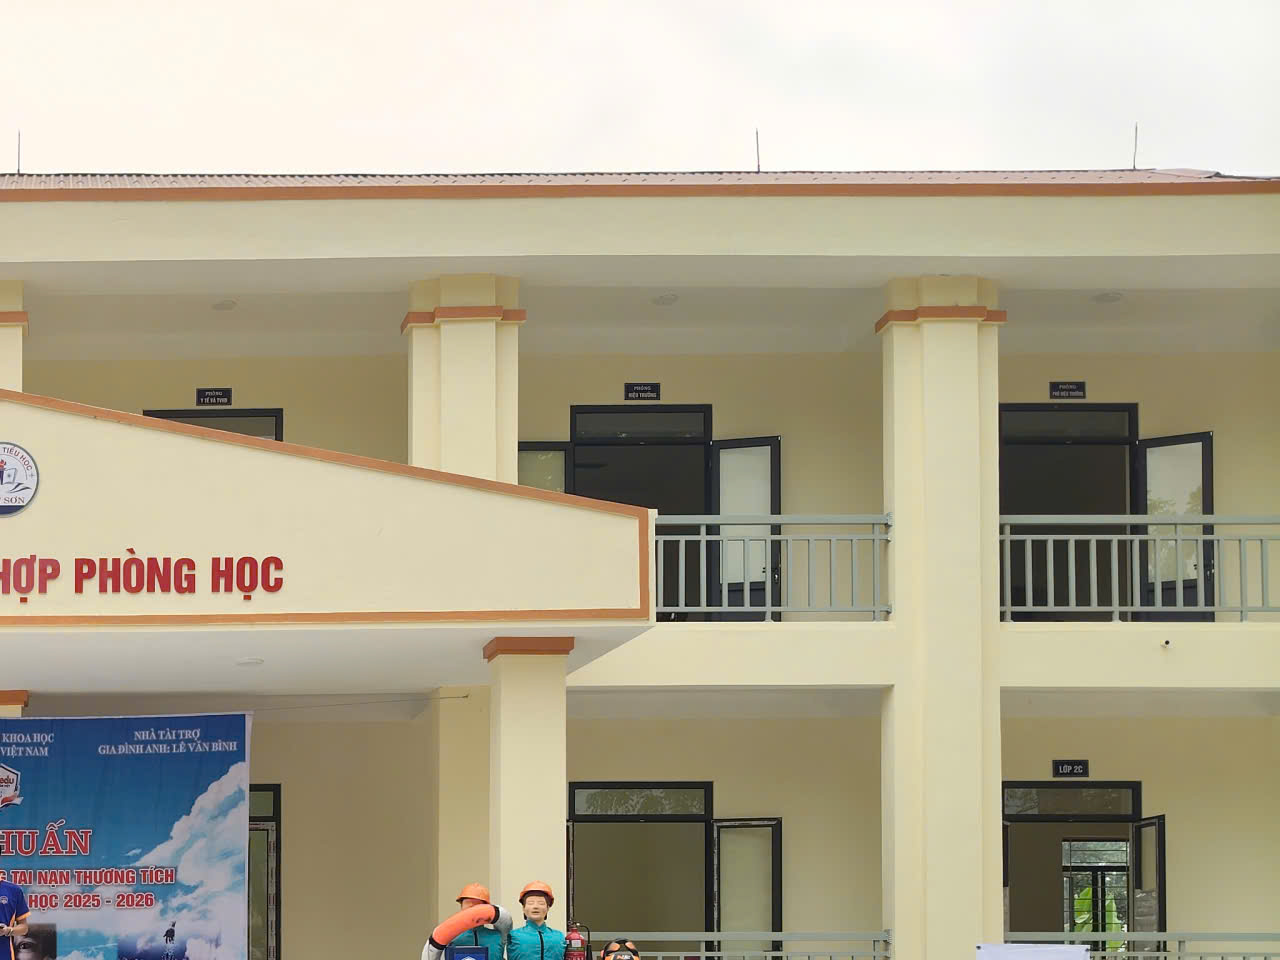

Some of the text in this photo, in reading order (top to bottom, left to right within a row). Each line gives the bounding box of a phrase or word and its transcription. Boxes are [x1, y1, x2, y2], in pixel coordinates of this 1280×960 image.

[3, 496, 25, 505] SƠN
[74, 548, 196, 594] PHÒNG
[211, 555, 284, 600] HỌC
[2, 733, 31, 743] KHOA
[33, 733, 55, 745] HỌC
[134, 728, 201, 741] NHÀ TÀI TRỢ
[0, 744, 25, 759] VIỆT
[25, 746, 49, 757] NAM
[98, 739, 238, 755] GIA ĐÌNH ANH: LÊ VĂN BÌNH
[1059, 764, 1083, 773] LỚP 2C
[11, 870, 33, 885] TAI
[37, 870, 70, 888] NẠN
[74, 867, 136, 885] THƯƠNG
[139, 866, 176, 884] TÍCH
[28, 893, 59, 911] HỌC
[63, 893, 101, 908] 2025
[116, 892, 155, 908] 2026
